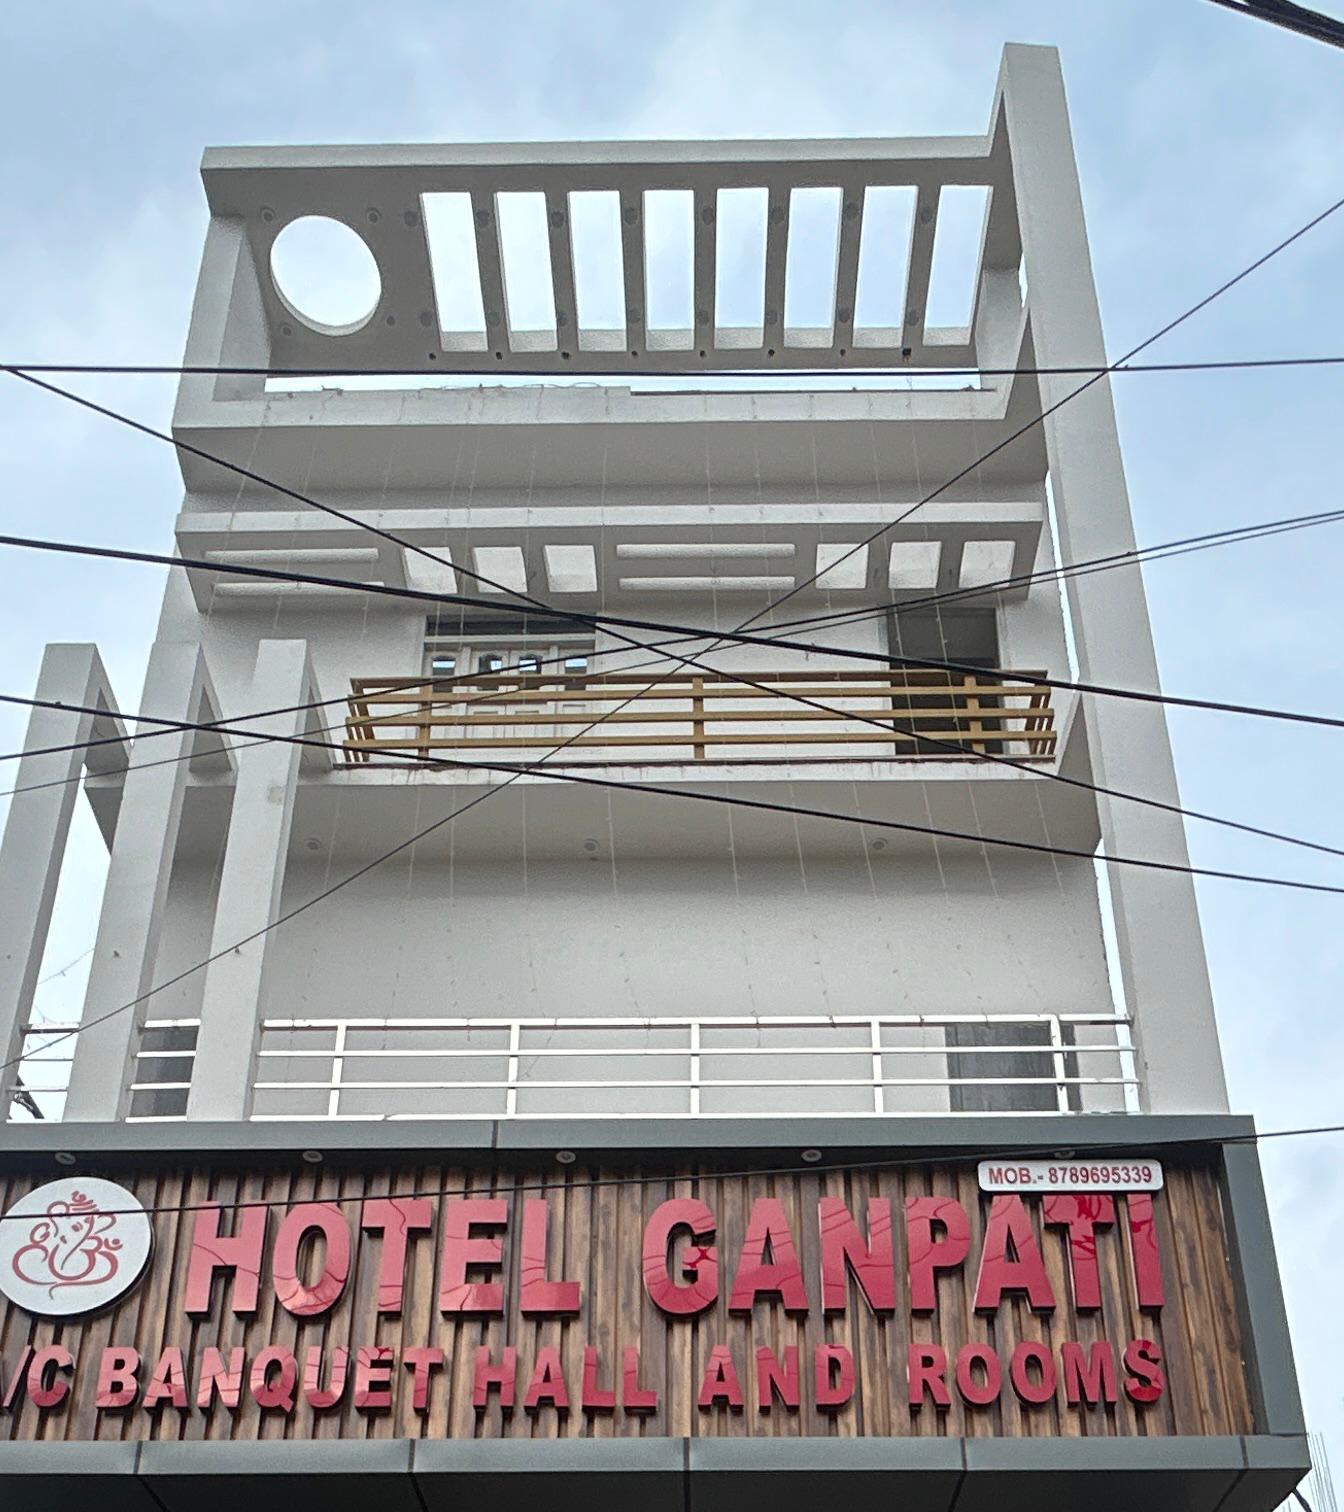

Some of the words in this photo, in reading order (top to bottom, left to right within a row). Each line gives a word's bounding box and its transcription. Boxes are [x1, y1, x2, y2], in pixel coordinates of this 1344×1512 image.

[1048, 1165, 1153, 1184] 8789695339
[184, 1198, 582, 1317] HOTEL
[642, 1195, 1165, 1318] GANPATI
[95, 1344, 444, 1413] BANQUET
[472, 1345, 657, 1411] HALL
[698, 1343, 856, 1411] AND
[906, 1339, 1165, 1411] ROOMS
